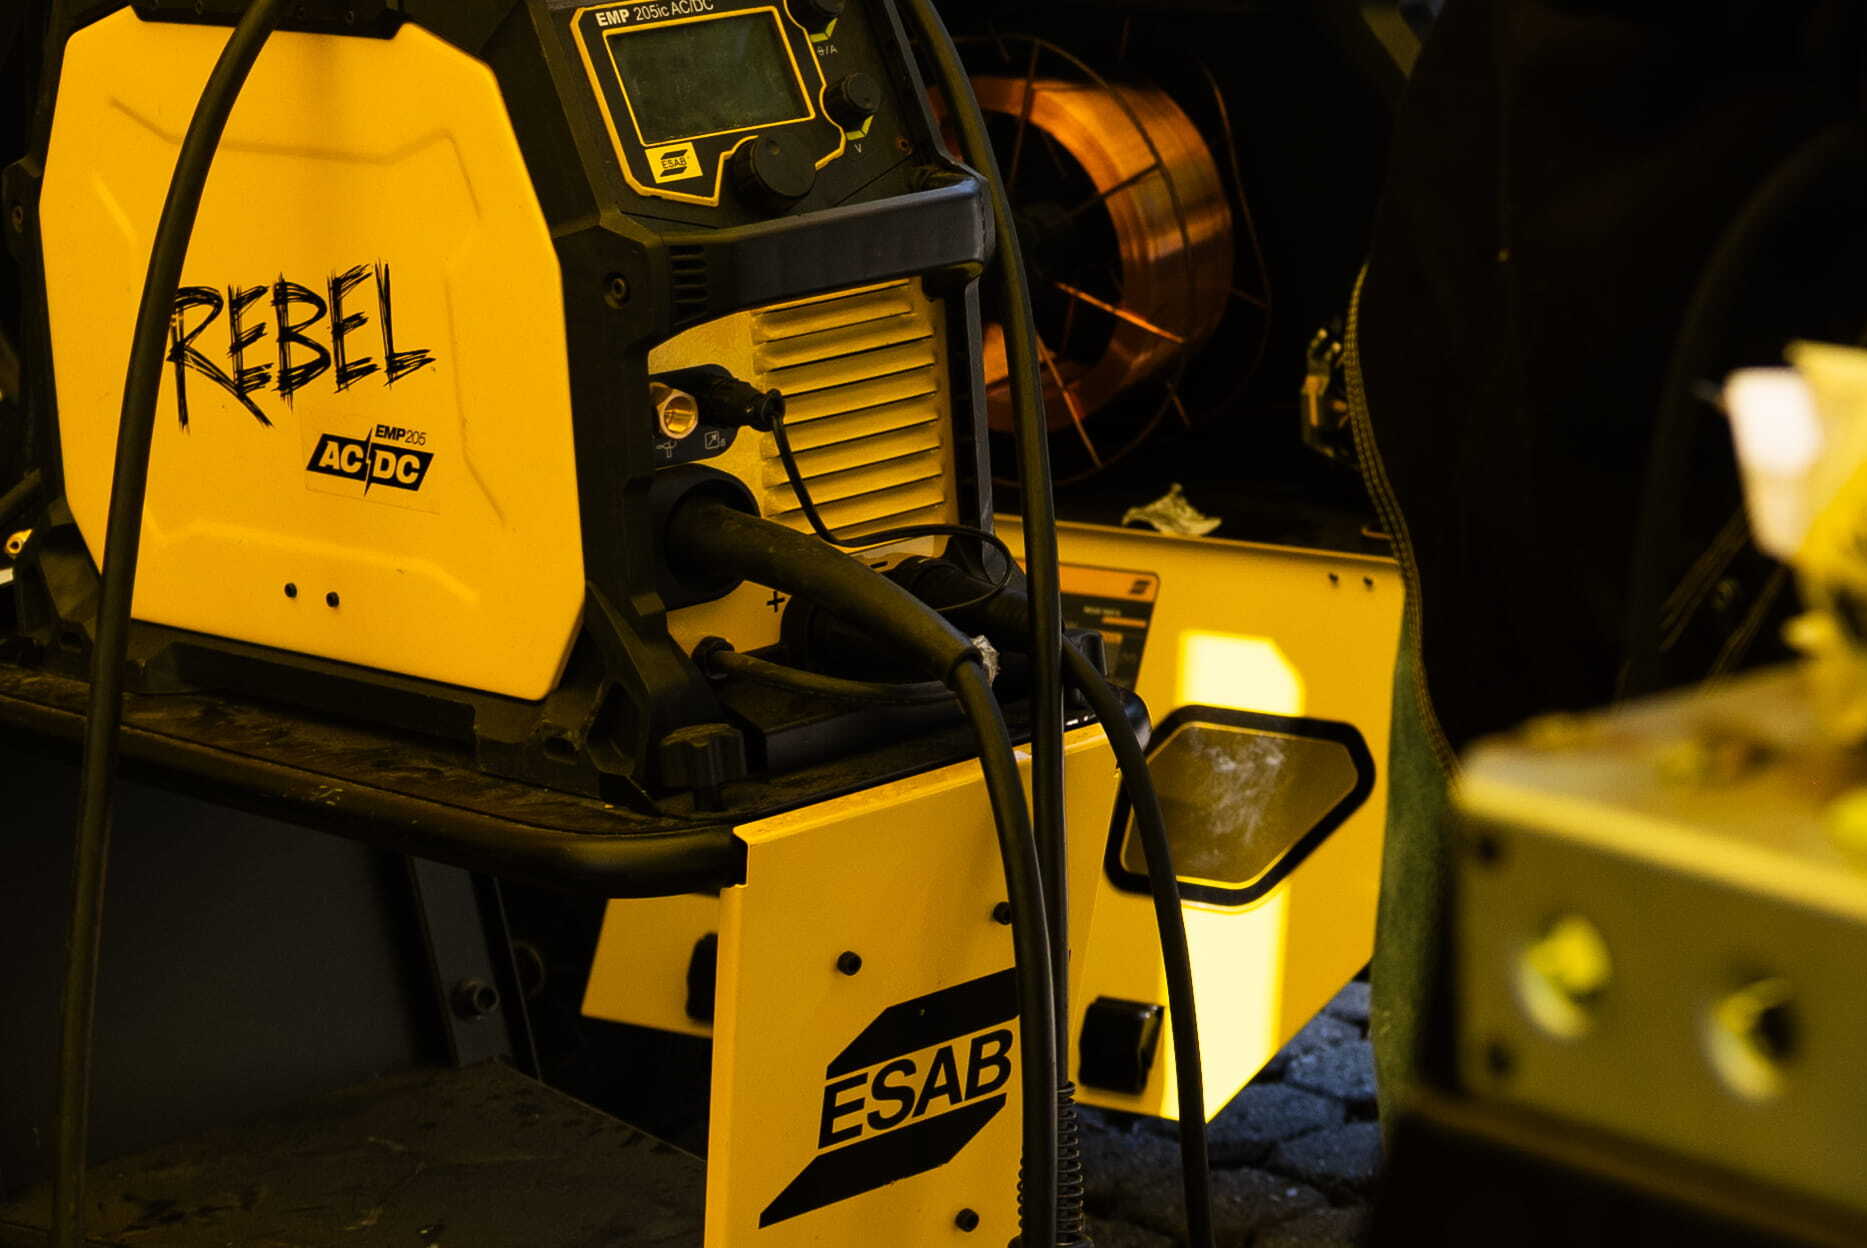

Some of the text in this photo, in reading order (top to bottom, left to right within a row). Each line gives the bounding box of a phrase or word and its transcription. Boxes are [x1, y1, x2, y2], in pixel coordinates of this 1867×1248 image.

[595, 8, 630, 28] EMP
[633, 2, 670, 22] 205ic
[166, 257, 437, 436] REBEL
[817, 1028, 1014, 1151] ESAB
